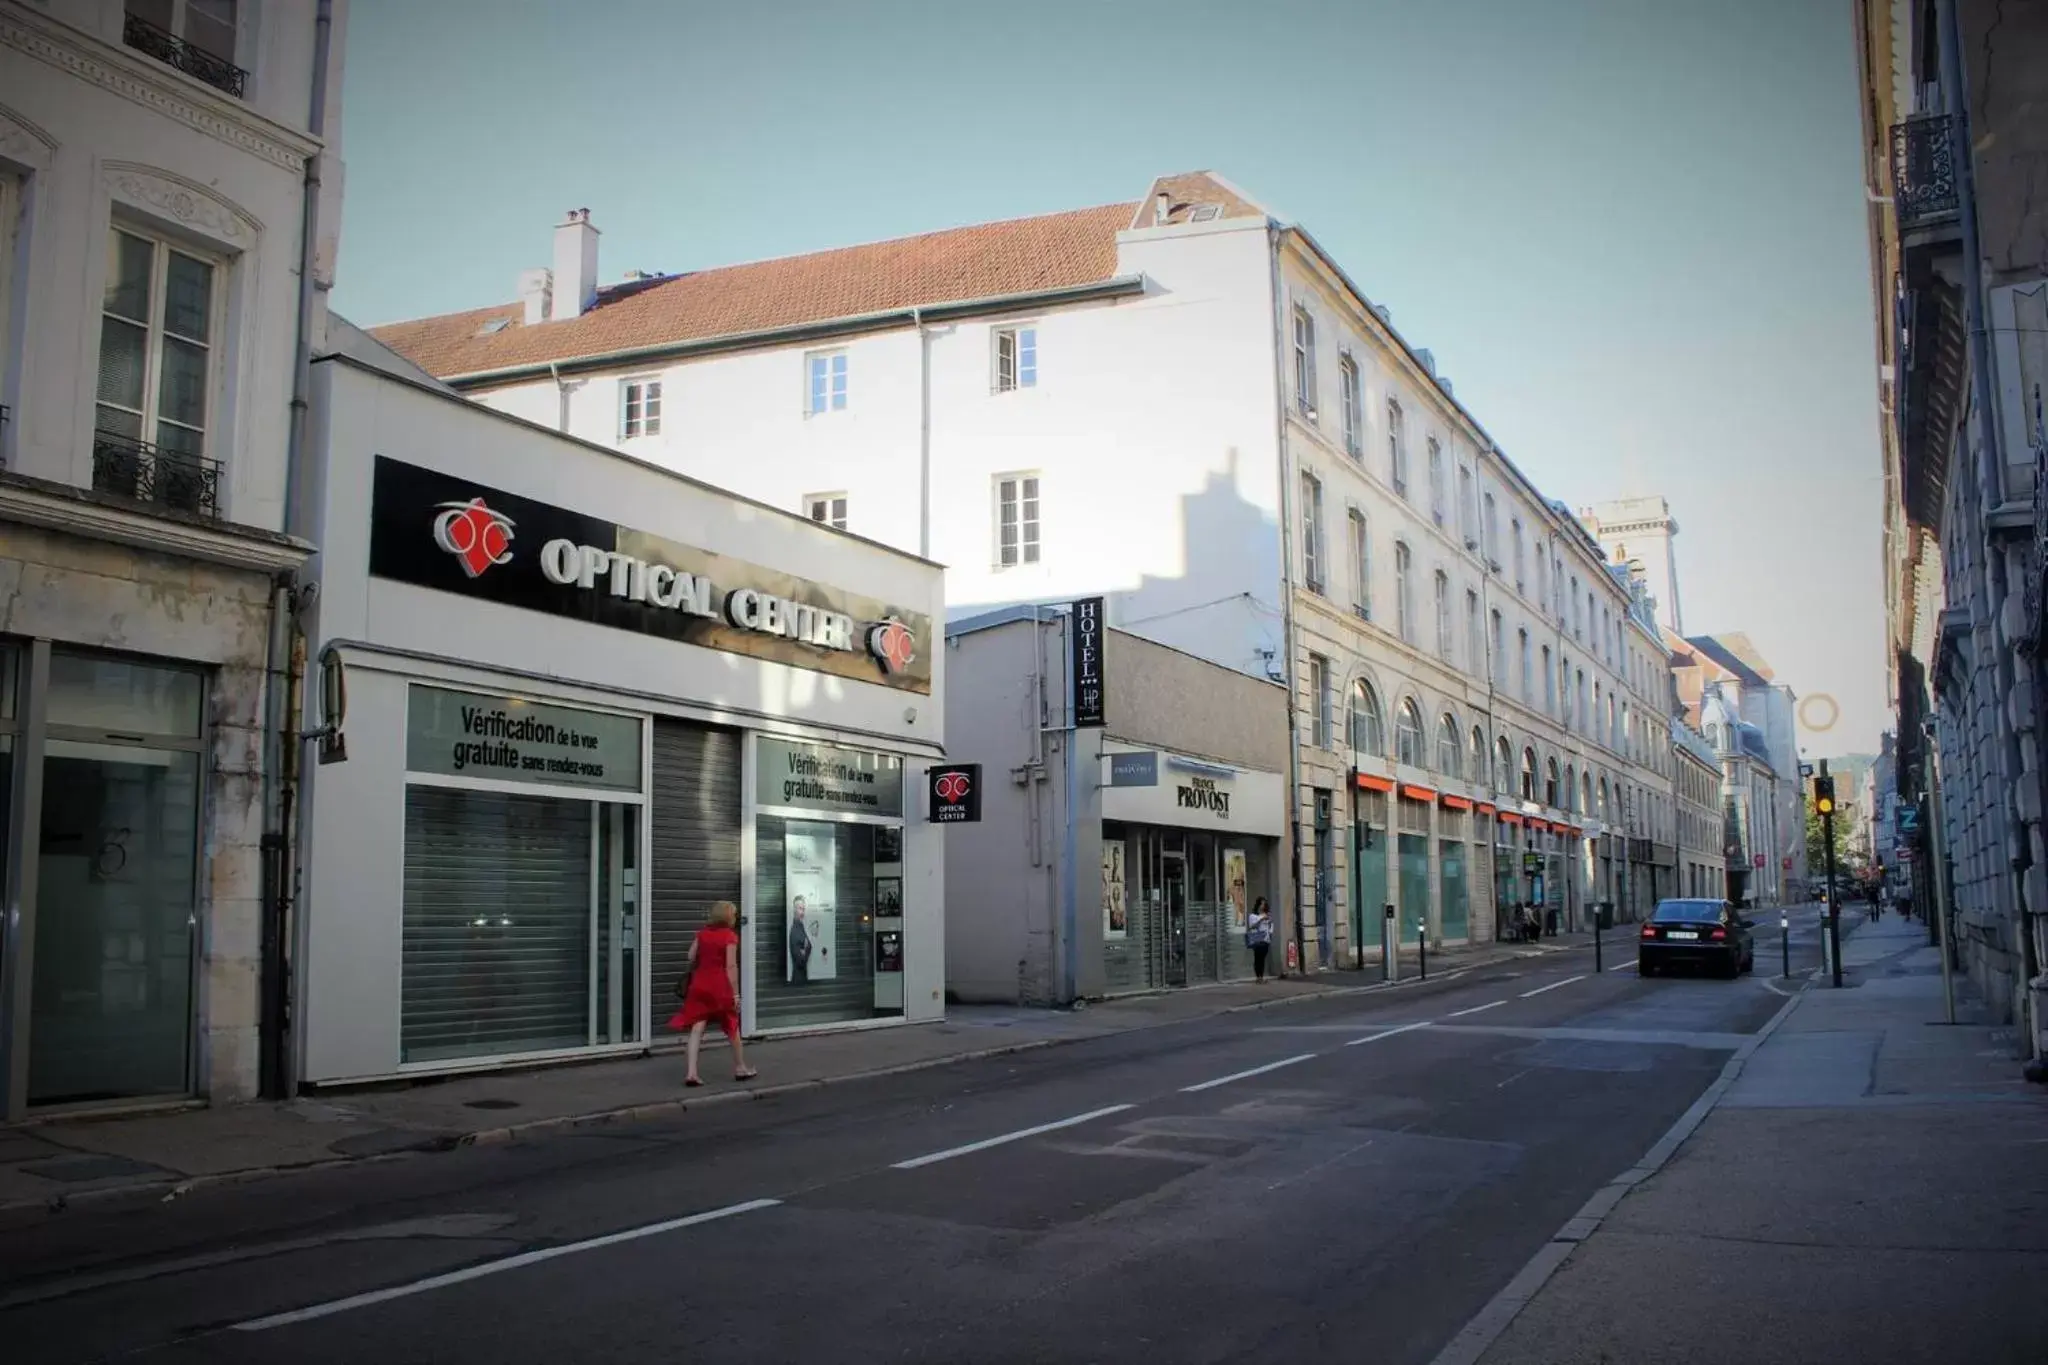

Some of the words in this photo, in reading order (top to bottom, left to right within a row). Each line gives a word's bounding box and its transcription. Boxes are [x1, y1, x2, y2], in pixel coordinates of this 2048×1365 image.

[540, 538, 718, 618] OPTICAL
[730, 588, 854, 651] CENTER
[1080, 602, 1096, 678] HOTEL
[461, 705, 555, 744] Vérification
[557, 730, 569, 746] de
[570, 729, 580, 749] la
[581, 735, 599, 750] vue
[453, 741, 519, 770] gratuite
[521, 755, 545, 772] sans
[546, 757, 604, 777] rendez-vous
[788, 751, 847, 780] Vérification
[783, 779, 825, 802] gratuite
[1177, 785, 1230, 812] PROVOST
[938, 812, 967, 821] CENTER
[939, 805, 967, 813] OPTICAL
